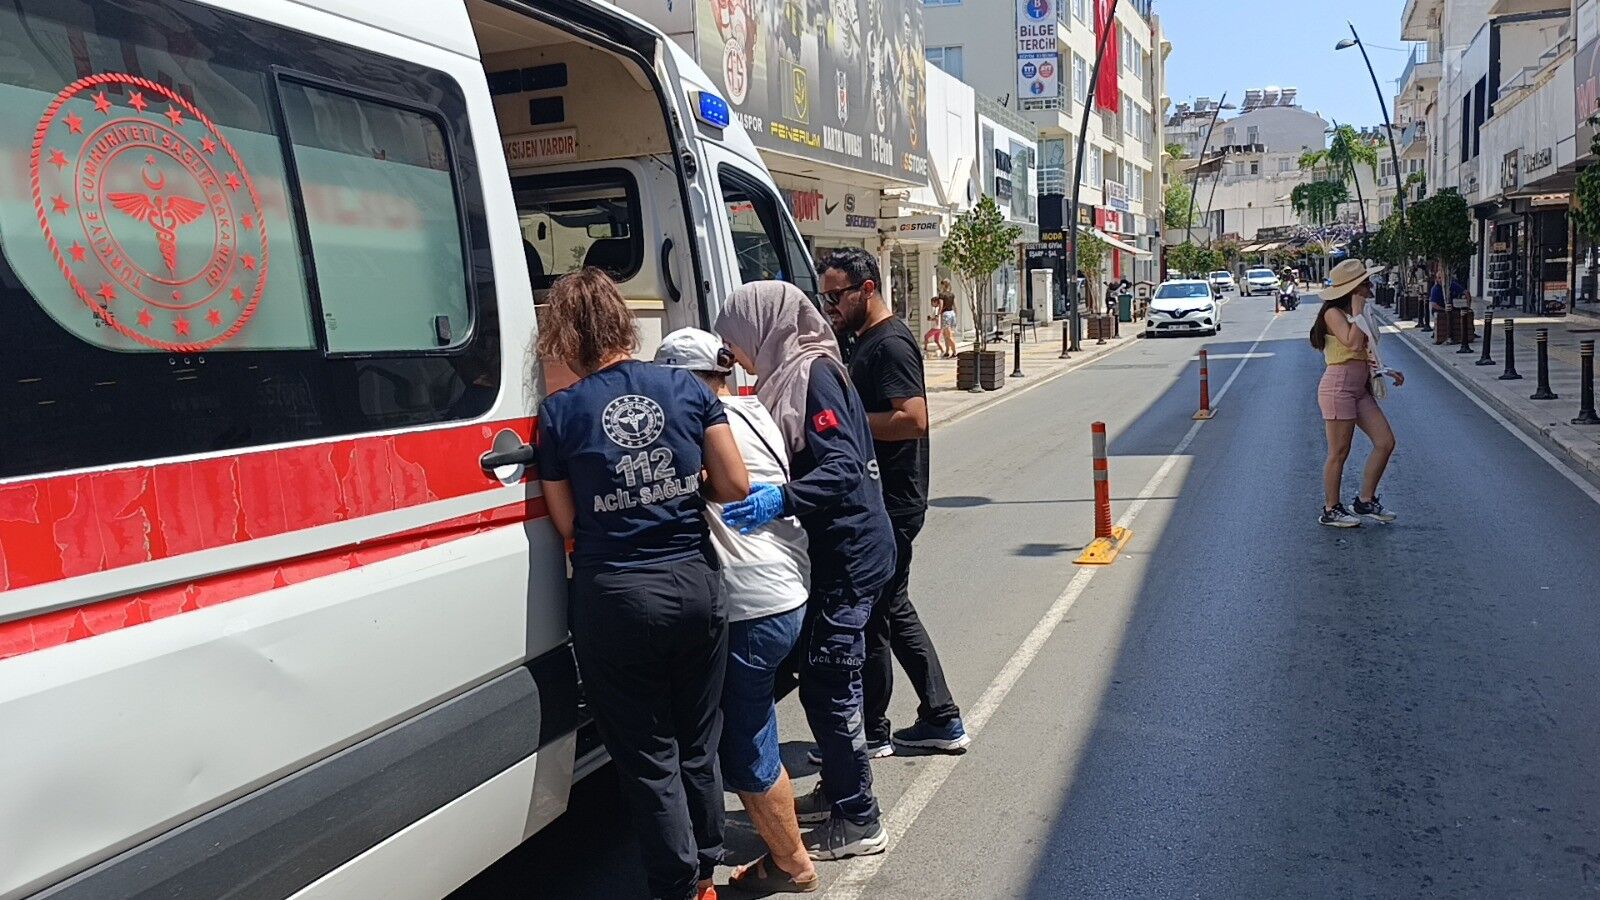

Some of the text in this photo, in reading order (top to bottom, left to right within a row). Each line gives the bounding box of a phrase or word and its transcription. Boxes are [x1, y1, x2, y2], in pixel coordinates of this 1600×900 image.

[505, 135, 574, 160] KSiJEN VARDIR
[899, 222, 938, 231] GSSTORE
[615, 447, 676, 487] 112
[593, 488, 637, 513] ACİL
